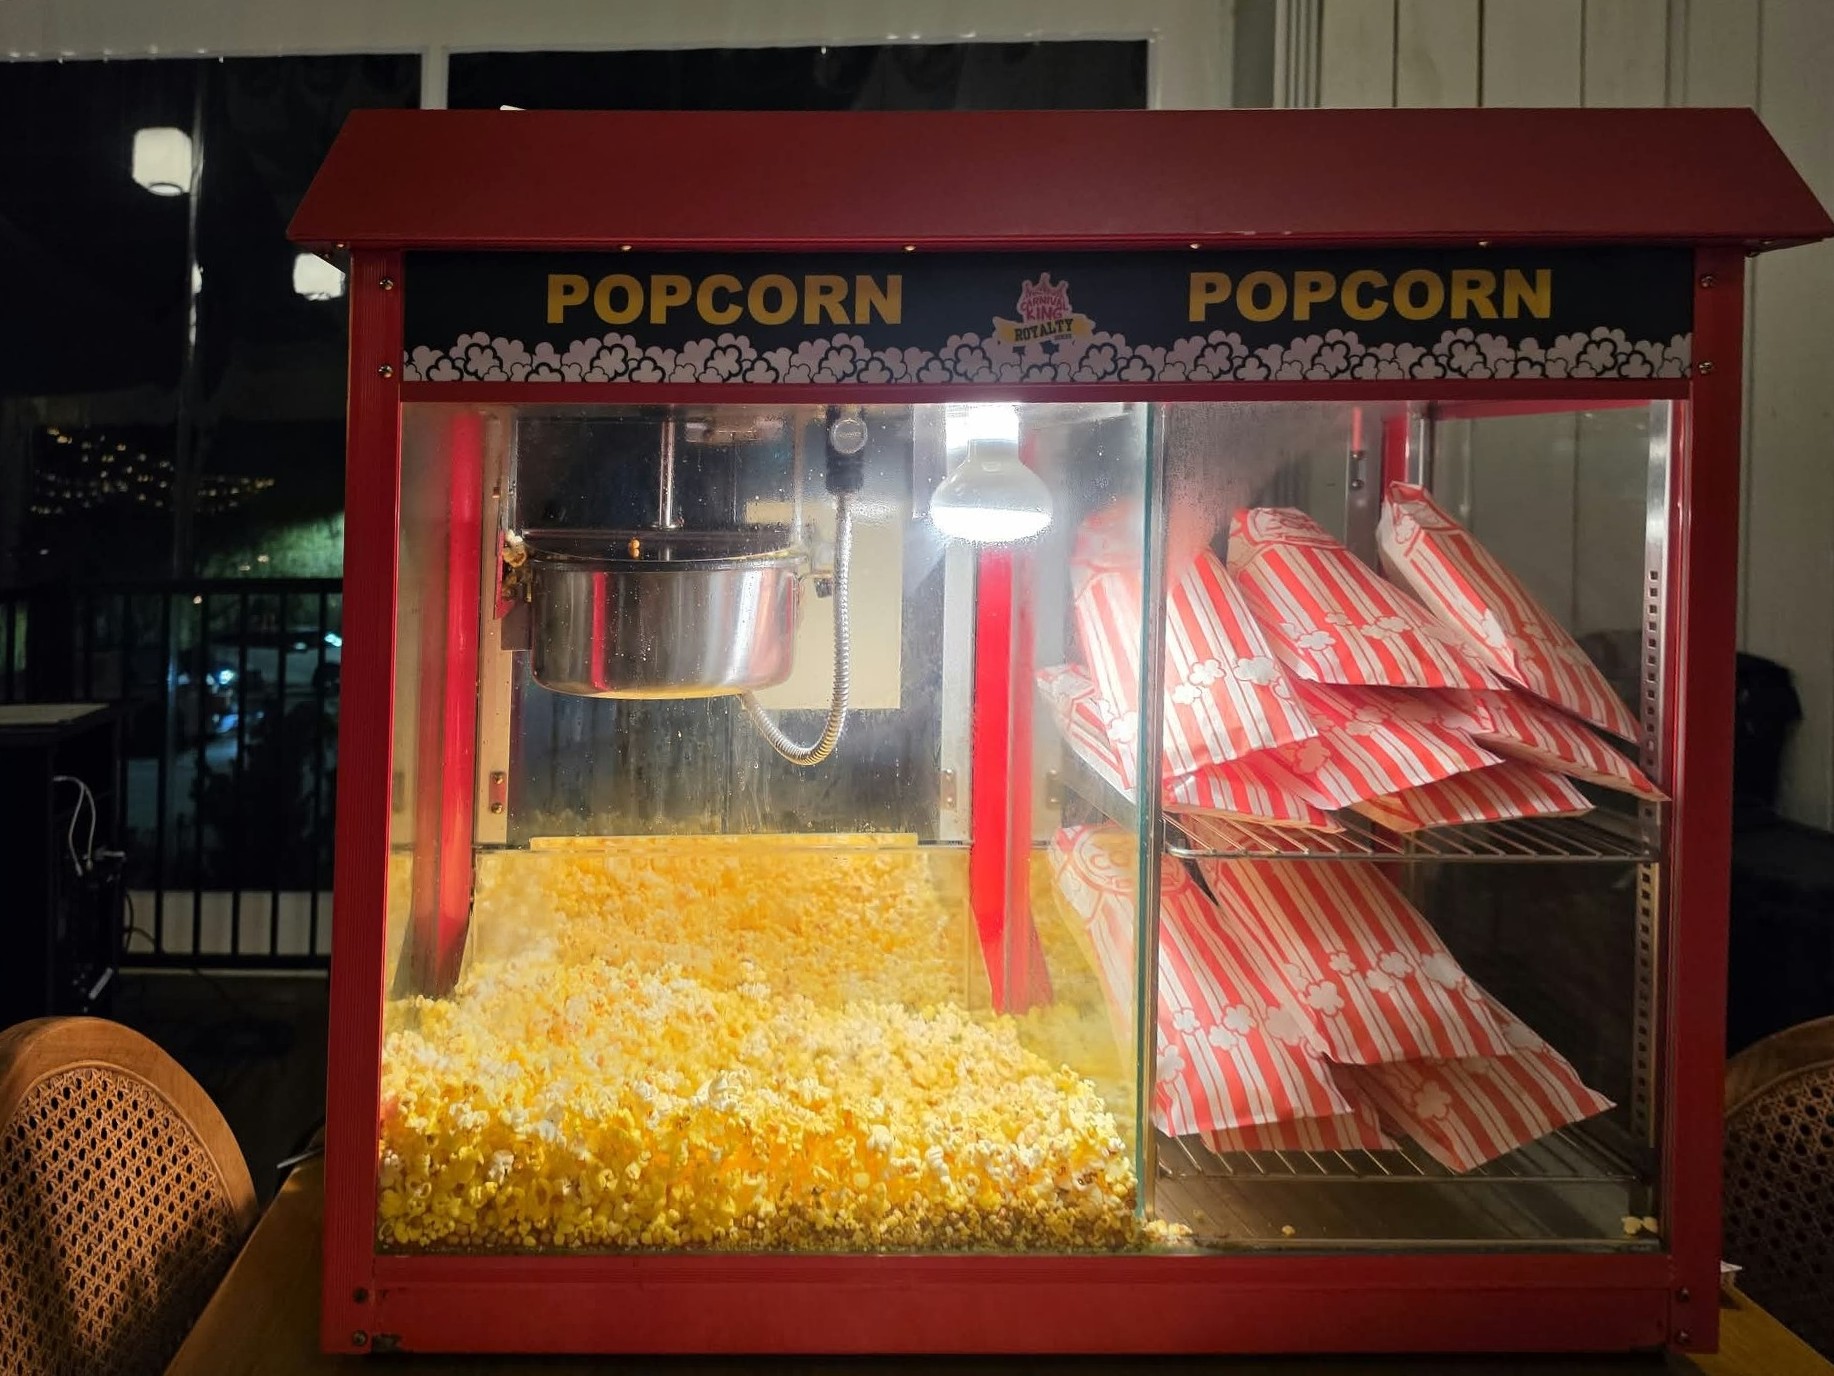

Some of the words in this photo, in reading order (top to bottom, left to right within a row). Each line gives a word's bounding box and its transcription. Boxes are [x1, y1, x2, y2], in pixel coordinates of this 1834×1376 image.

[546, 273, 902, 326] POPCORN
[1020, 296, 1068, 311] CARNIVAL
[1188, 268, 1552, 322] POPCORN
[1026, 304, 1063, 320] KING
[1014, 318, 1074, 342] ROYALTY
